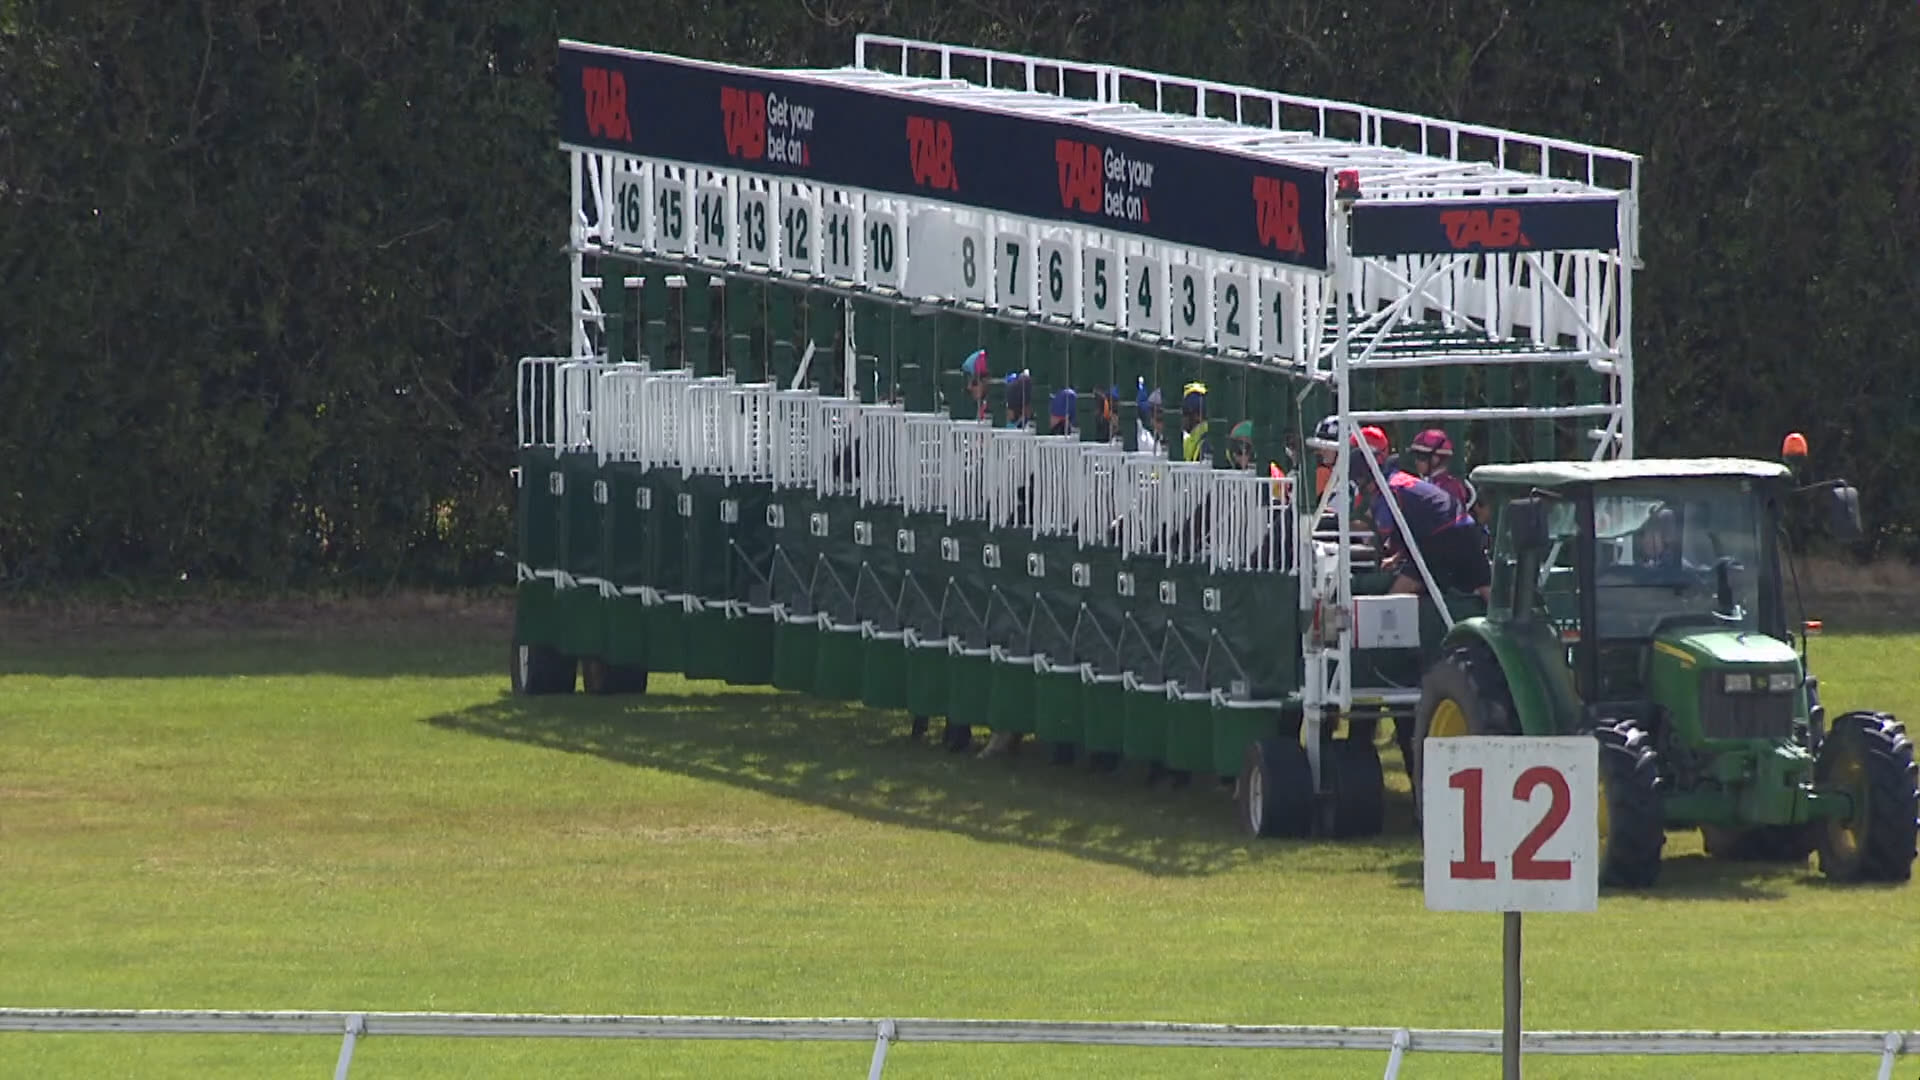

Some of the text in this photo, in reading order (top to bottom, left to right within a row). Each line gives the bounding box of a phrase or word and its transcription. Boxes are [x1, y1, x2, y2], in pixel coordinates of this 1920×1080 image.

[721, 86, 766, 159] TAB
[767, 92, 814, 132] Get your
[767, 131, 802, 165] bet on
[1104, 147, 1154, 191] Get your
[1055, 139, 1101, 213] TAB
[1104, 184, 1142, 219] bet on
[618, 182, 640, 233] 16
[660, 188, 682, 239] 15
[701, 196, 724, 246] 14
[744, 202, 766, 252] 13
[785, 208, 808, 259] 12
[829, 214, 849, 266] 11
[870, 222, 893, 272] 10
[962, 236, 976, 288] 8
[1006, 243, 1020, 294] 7
[1049, 250, 1063, 302] 6
[1094, 258, 1107, 310] 5
[1138, 266, 1151, 318] 4
[1183, 275, 1195, 325] 3
[1226, 284, 1240, 336] 2
[1273, 292, 1282, 344] 1
[1448, 765, 1572, 880] 12
